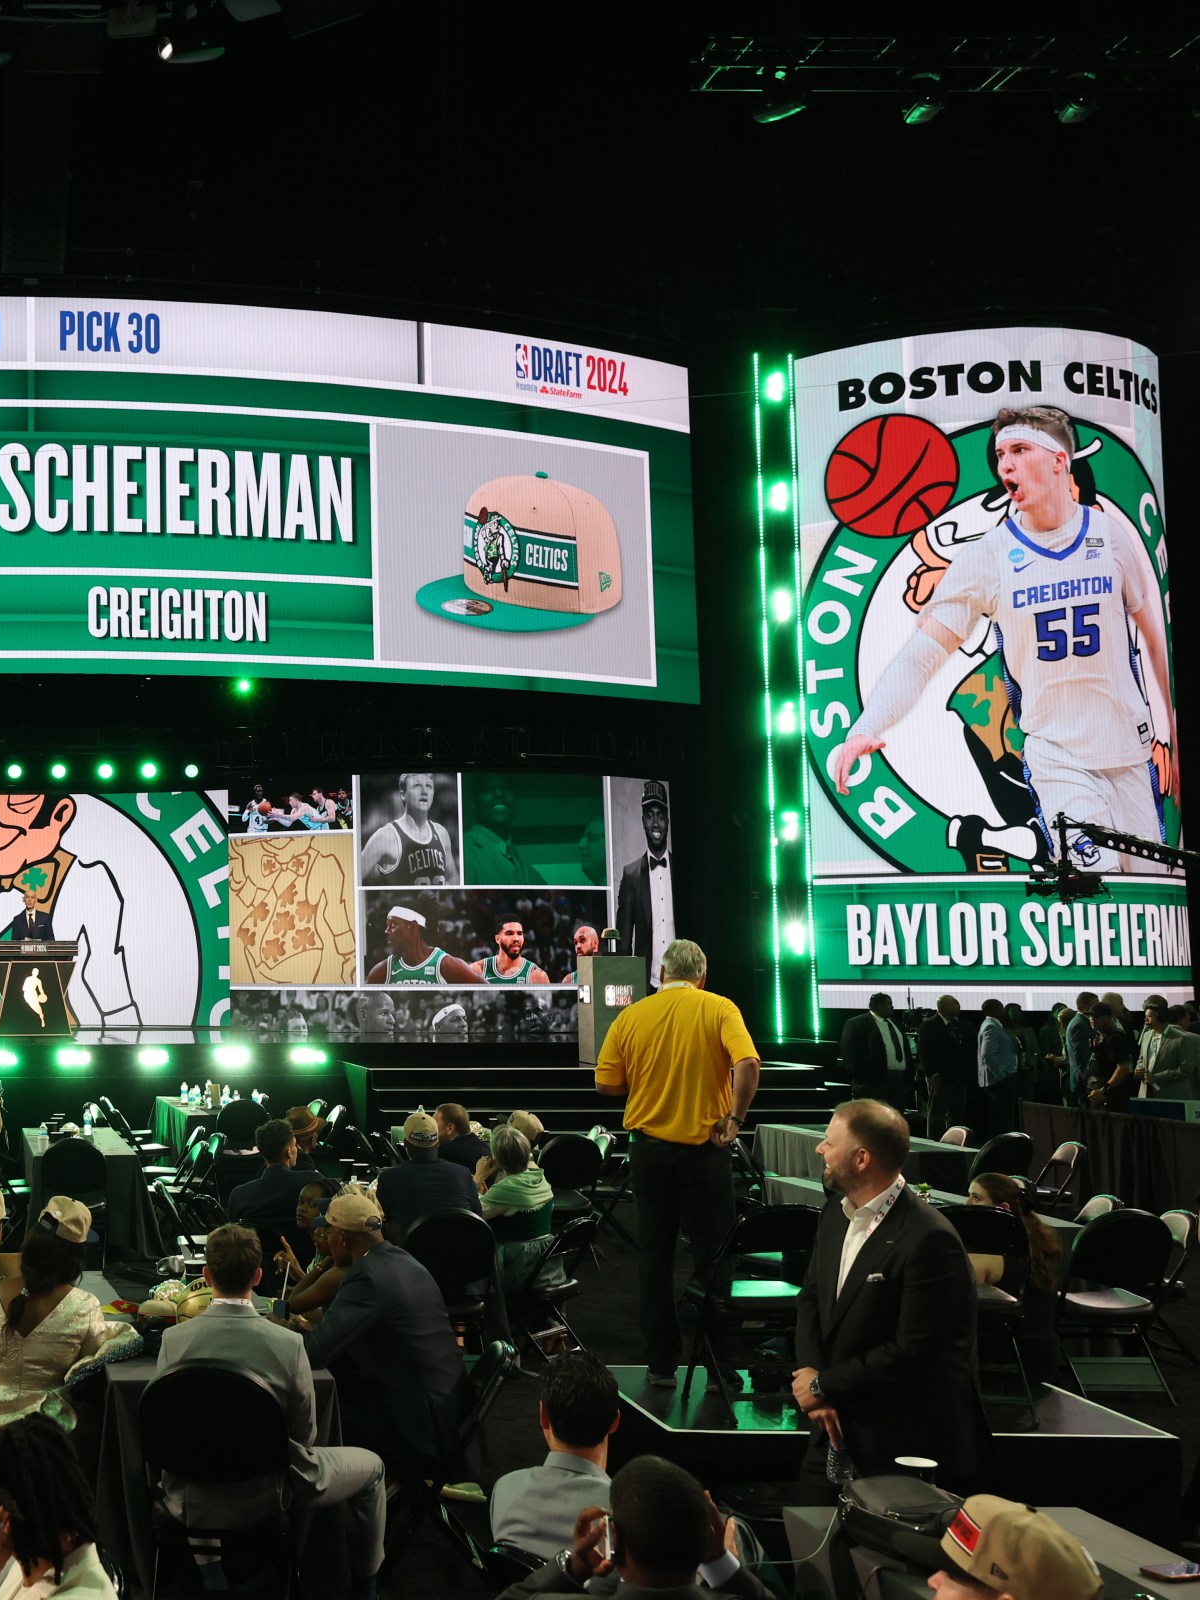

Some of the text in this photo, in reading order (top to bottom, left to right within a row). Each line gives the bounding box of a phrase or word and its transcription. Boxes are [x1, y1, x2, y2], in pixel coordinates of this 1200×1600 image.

[59, 311, 161, 354] PICK 30
[531, 345, 629, 397] DRAFT 2024
[837, 360, 1158, 415] BOSTON CELTICS
[525, 543, 569, 572] CELTICS
[87, 585, 267, 642] CREIGHTON
[1012, 576, 1112, 608] CREIGHTON
[1033, 602, 1100, 662] 55
[408, 848, 445, 875] CELTICS
[24, 944, 47, 952] DRAFT 2024
[846, 901, 1192, 967] BAYLOR SCHEIERMAN
